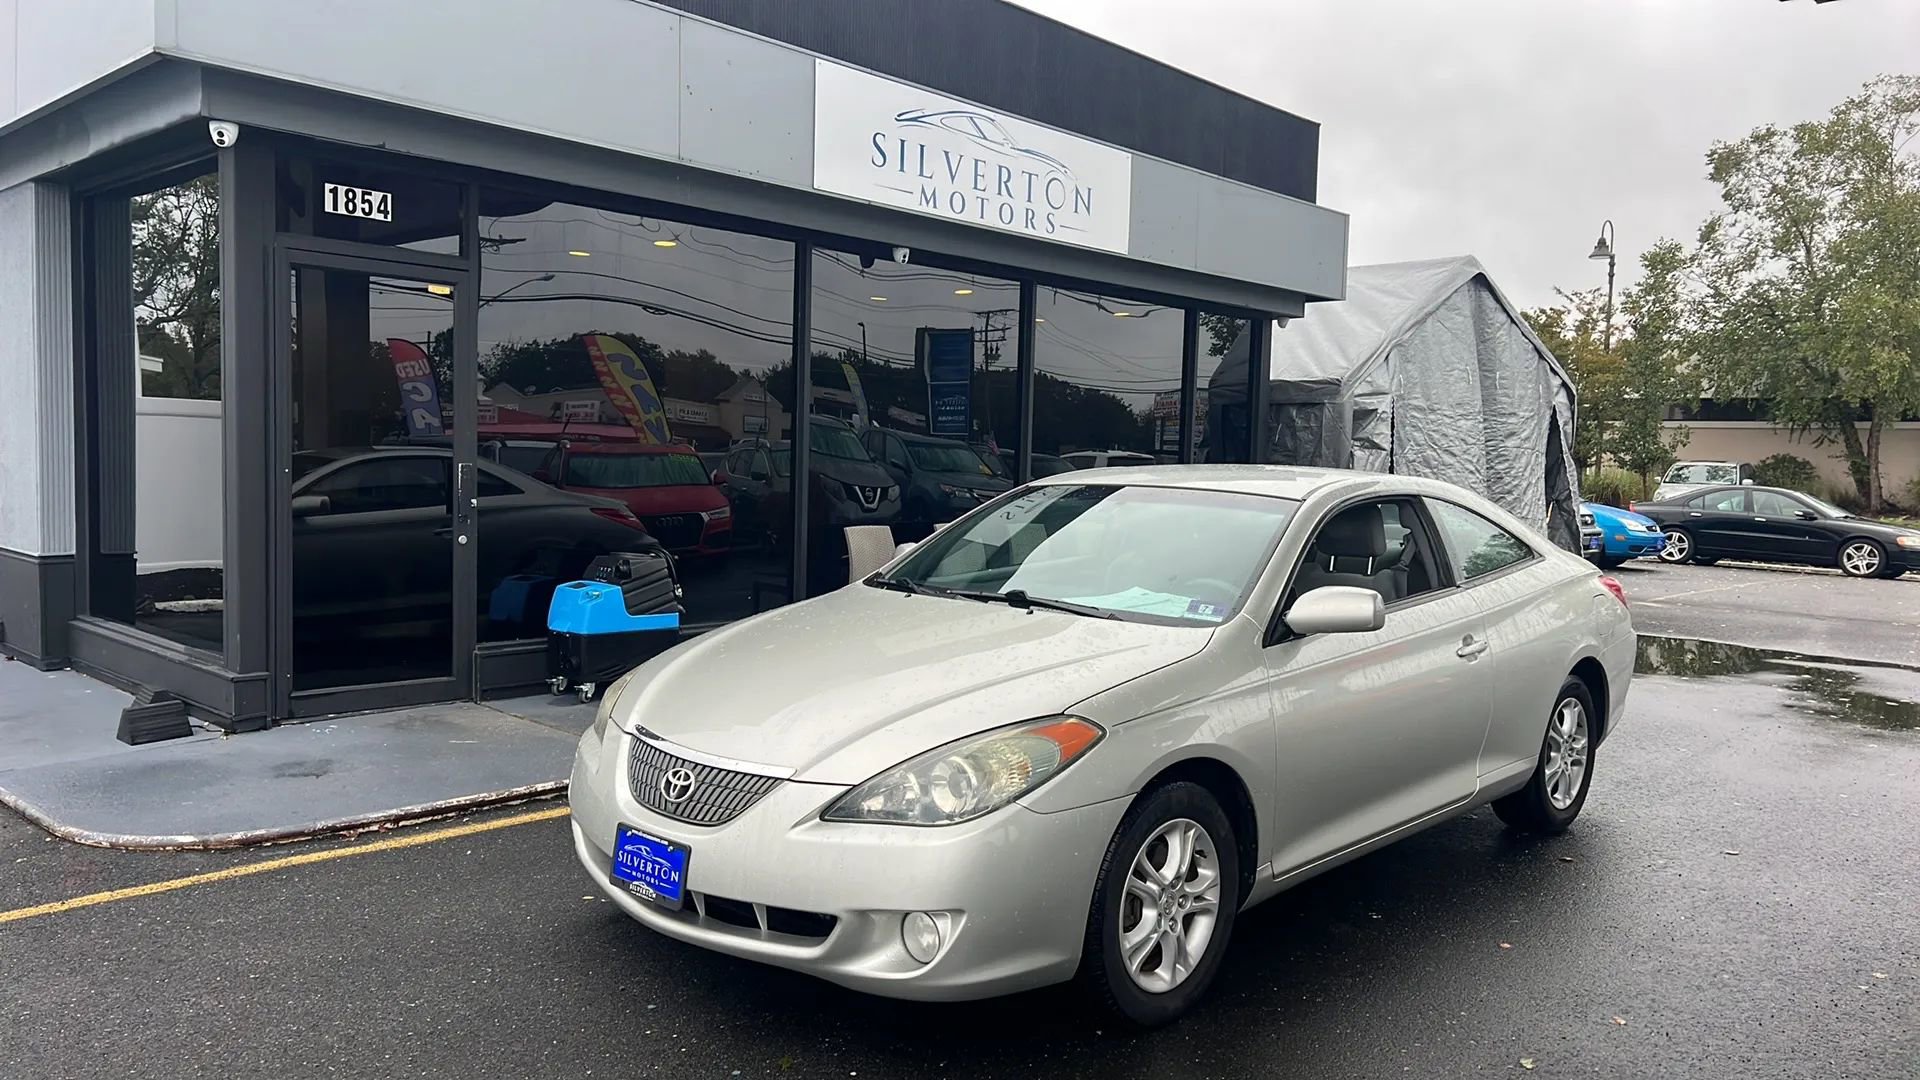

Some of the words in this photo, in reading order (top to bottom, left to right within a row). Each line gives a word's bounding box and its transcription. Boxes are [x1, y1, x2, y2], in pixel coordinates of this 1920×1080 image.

[871, 132, 1093, 217] SILVERTON
[329, 186, 390, 220] 1854
[919, 184, 1056, 234] MOTORS
[617, 850, 679, 882] SILVERTON
[631, 870, 659, 886] MOTORS
